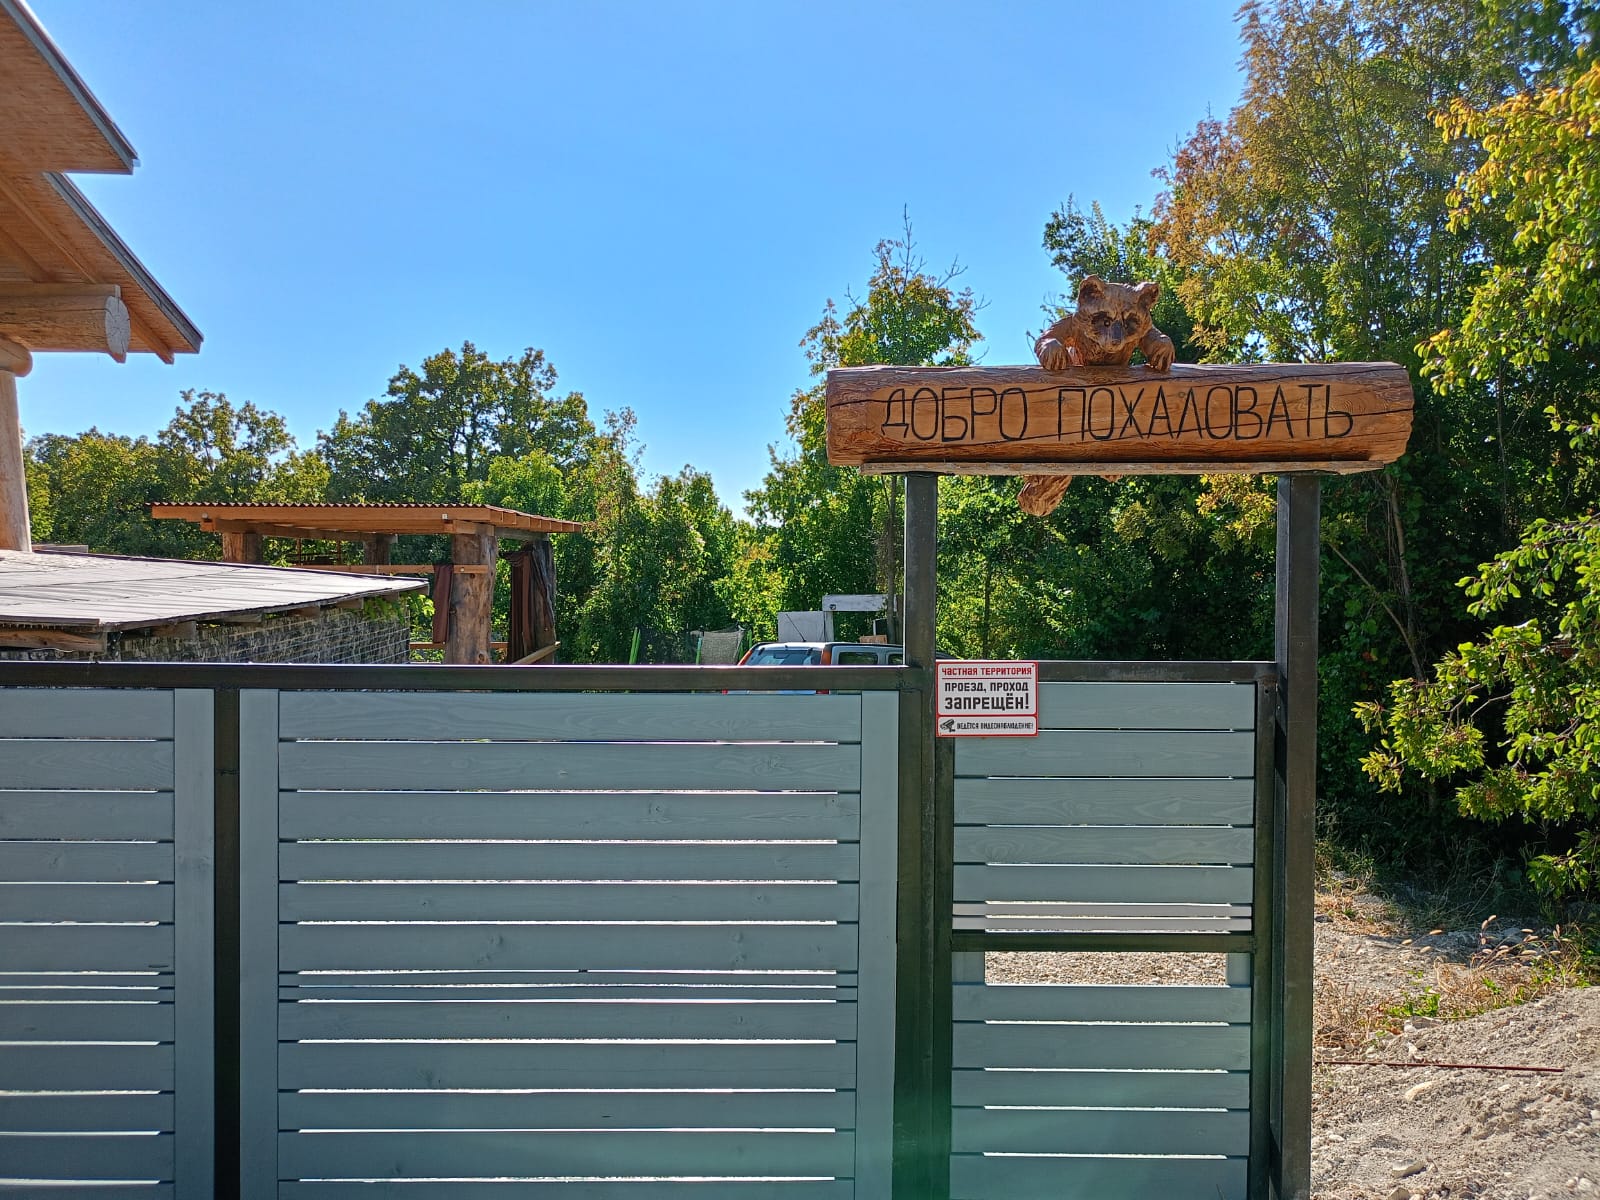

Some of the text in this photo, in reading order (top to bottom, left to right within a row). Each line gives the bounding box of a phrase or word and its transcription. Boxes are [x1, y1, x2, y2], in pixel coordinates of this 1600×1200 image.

[881, 384, 1354, 442] ДОБРО ПОЖАЛОВАТЬ
[981, 667, 1032, 675] ТЕРРИТОРИЯ
[944, 682, 1029, 693] ПРОЕЗД, ПРОХОД
